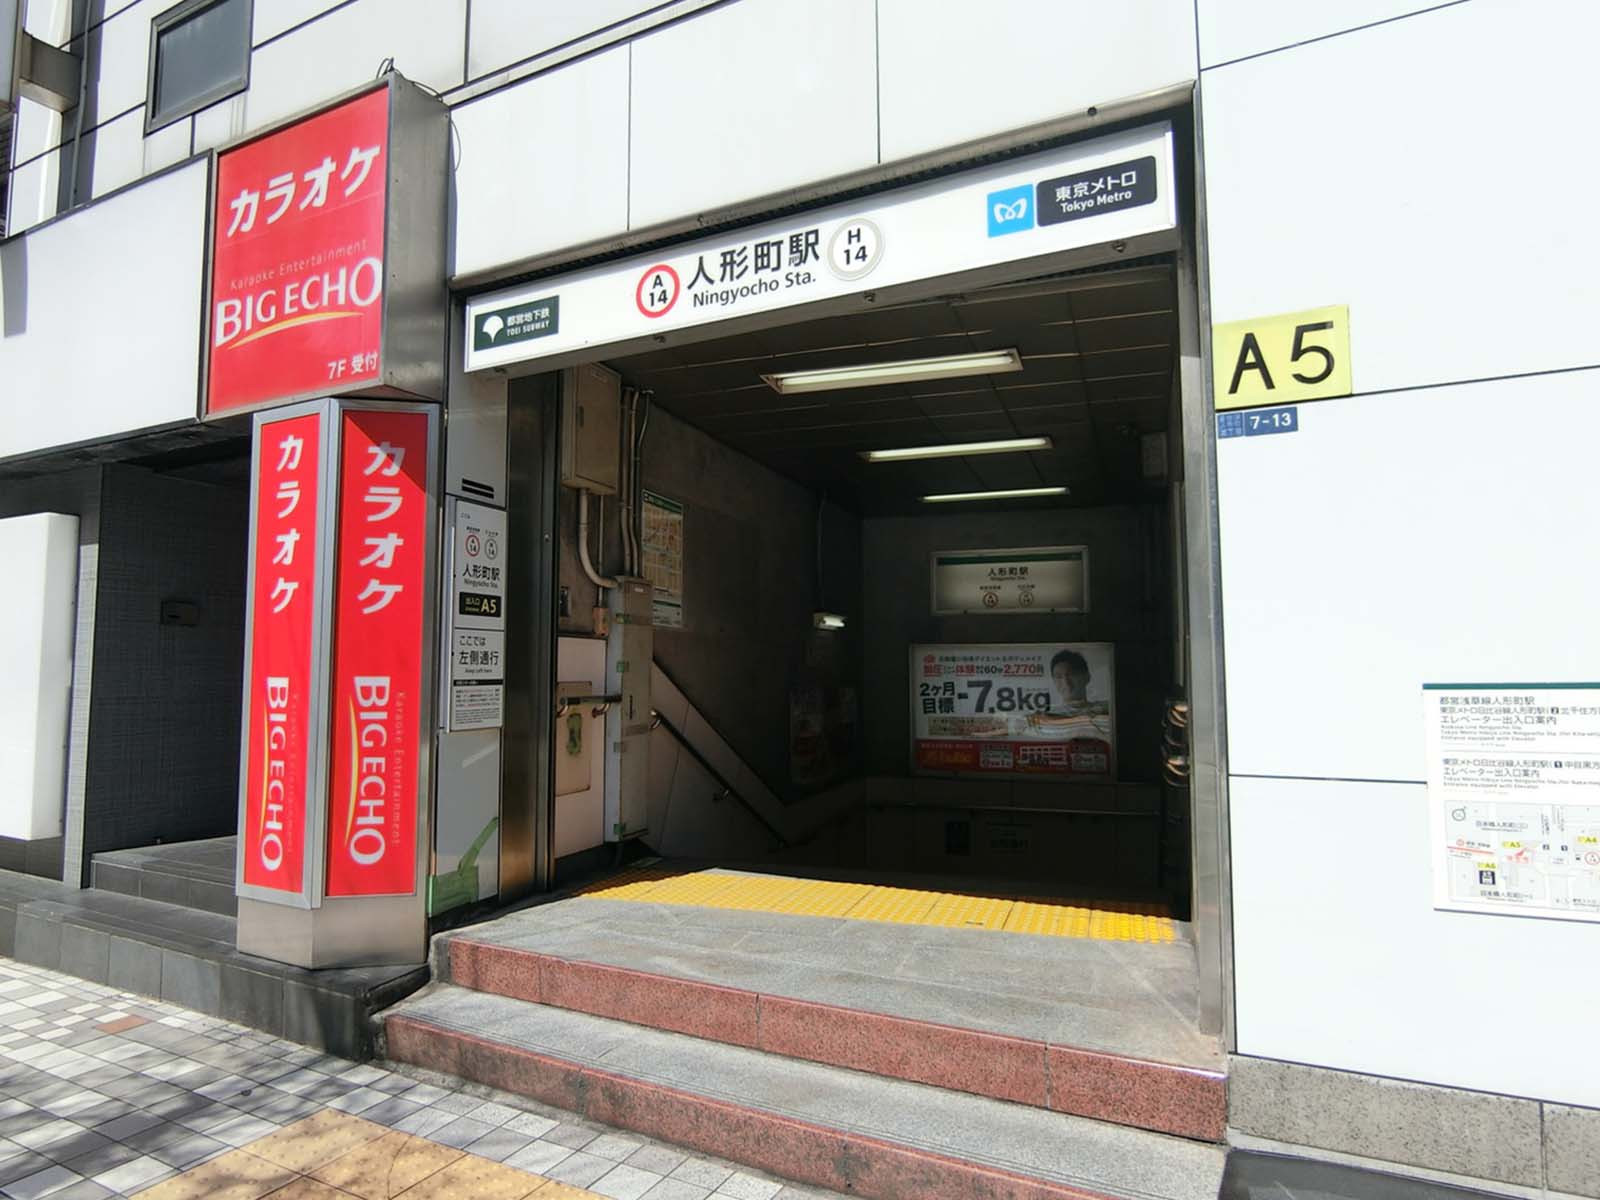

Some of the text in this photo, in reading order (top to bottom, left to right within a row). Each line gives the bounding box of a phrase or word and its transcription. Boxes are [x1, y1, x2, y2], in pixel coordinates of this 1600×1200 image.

[227, 144, 381, 237] カラオケ
[1055, 171, 1137, 202] 東京メトロ
[1060, 190, 1132, 213] Tokyo Metro
[847, 228, 861, 245] H
[231, 239, 367, 291] Karaoke Entertainment
[686, 229, 820, 290] 人形町駅
[843, 245, 868, 265] 14
[652, 274, 664, 289] A
[692, 271, 816, 307] Ningyocho Sta.
[215, 256, 383, 347] BIG ECHO
[649, 289, 668, 307] 14
[506, 307, 550, 327] 都営地下鉄
[506, 321, 549, 337] TOEI SUBWAY
[327, 351, 378, 379] 7F 受付
[1249, 412, 1292, 430] 7-13
[270, 435, 304, 613] カラオケ
[357, 441, 405, 614] カラオケ
[463, 563, 501, 581] 人形町駅
[481, 598, 497, 613] A5
[459, 650, 499, 665] 左側通行
[922, 698, 955, 714] 目標
[260, 677, 289, 871] BIG ECHO
[349, 676, 391, 865] BIG ECHO
